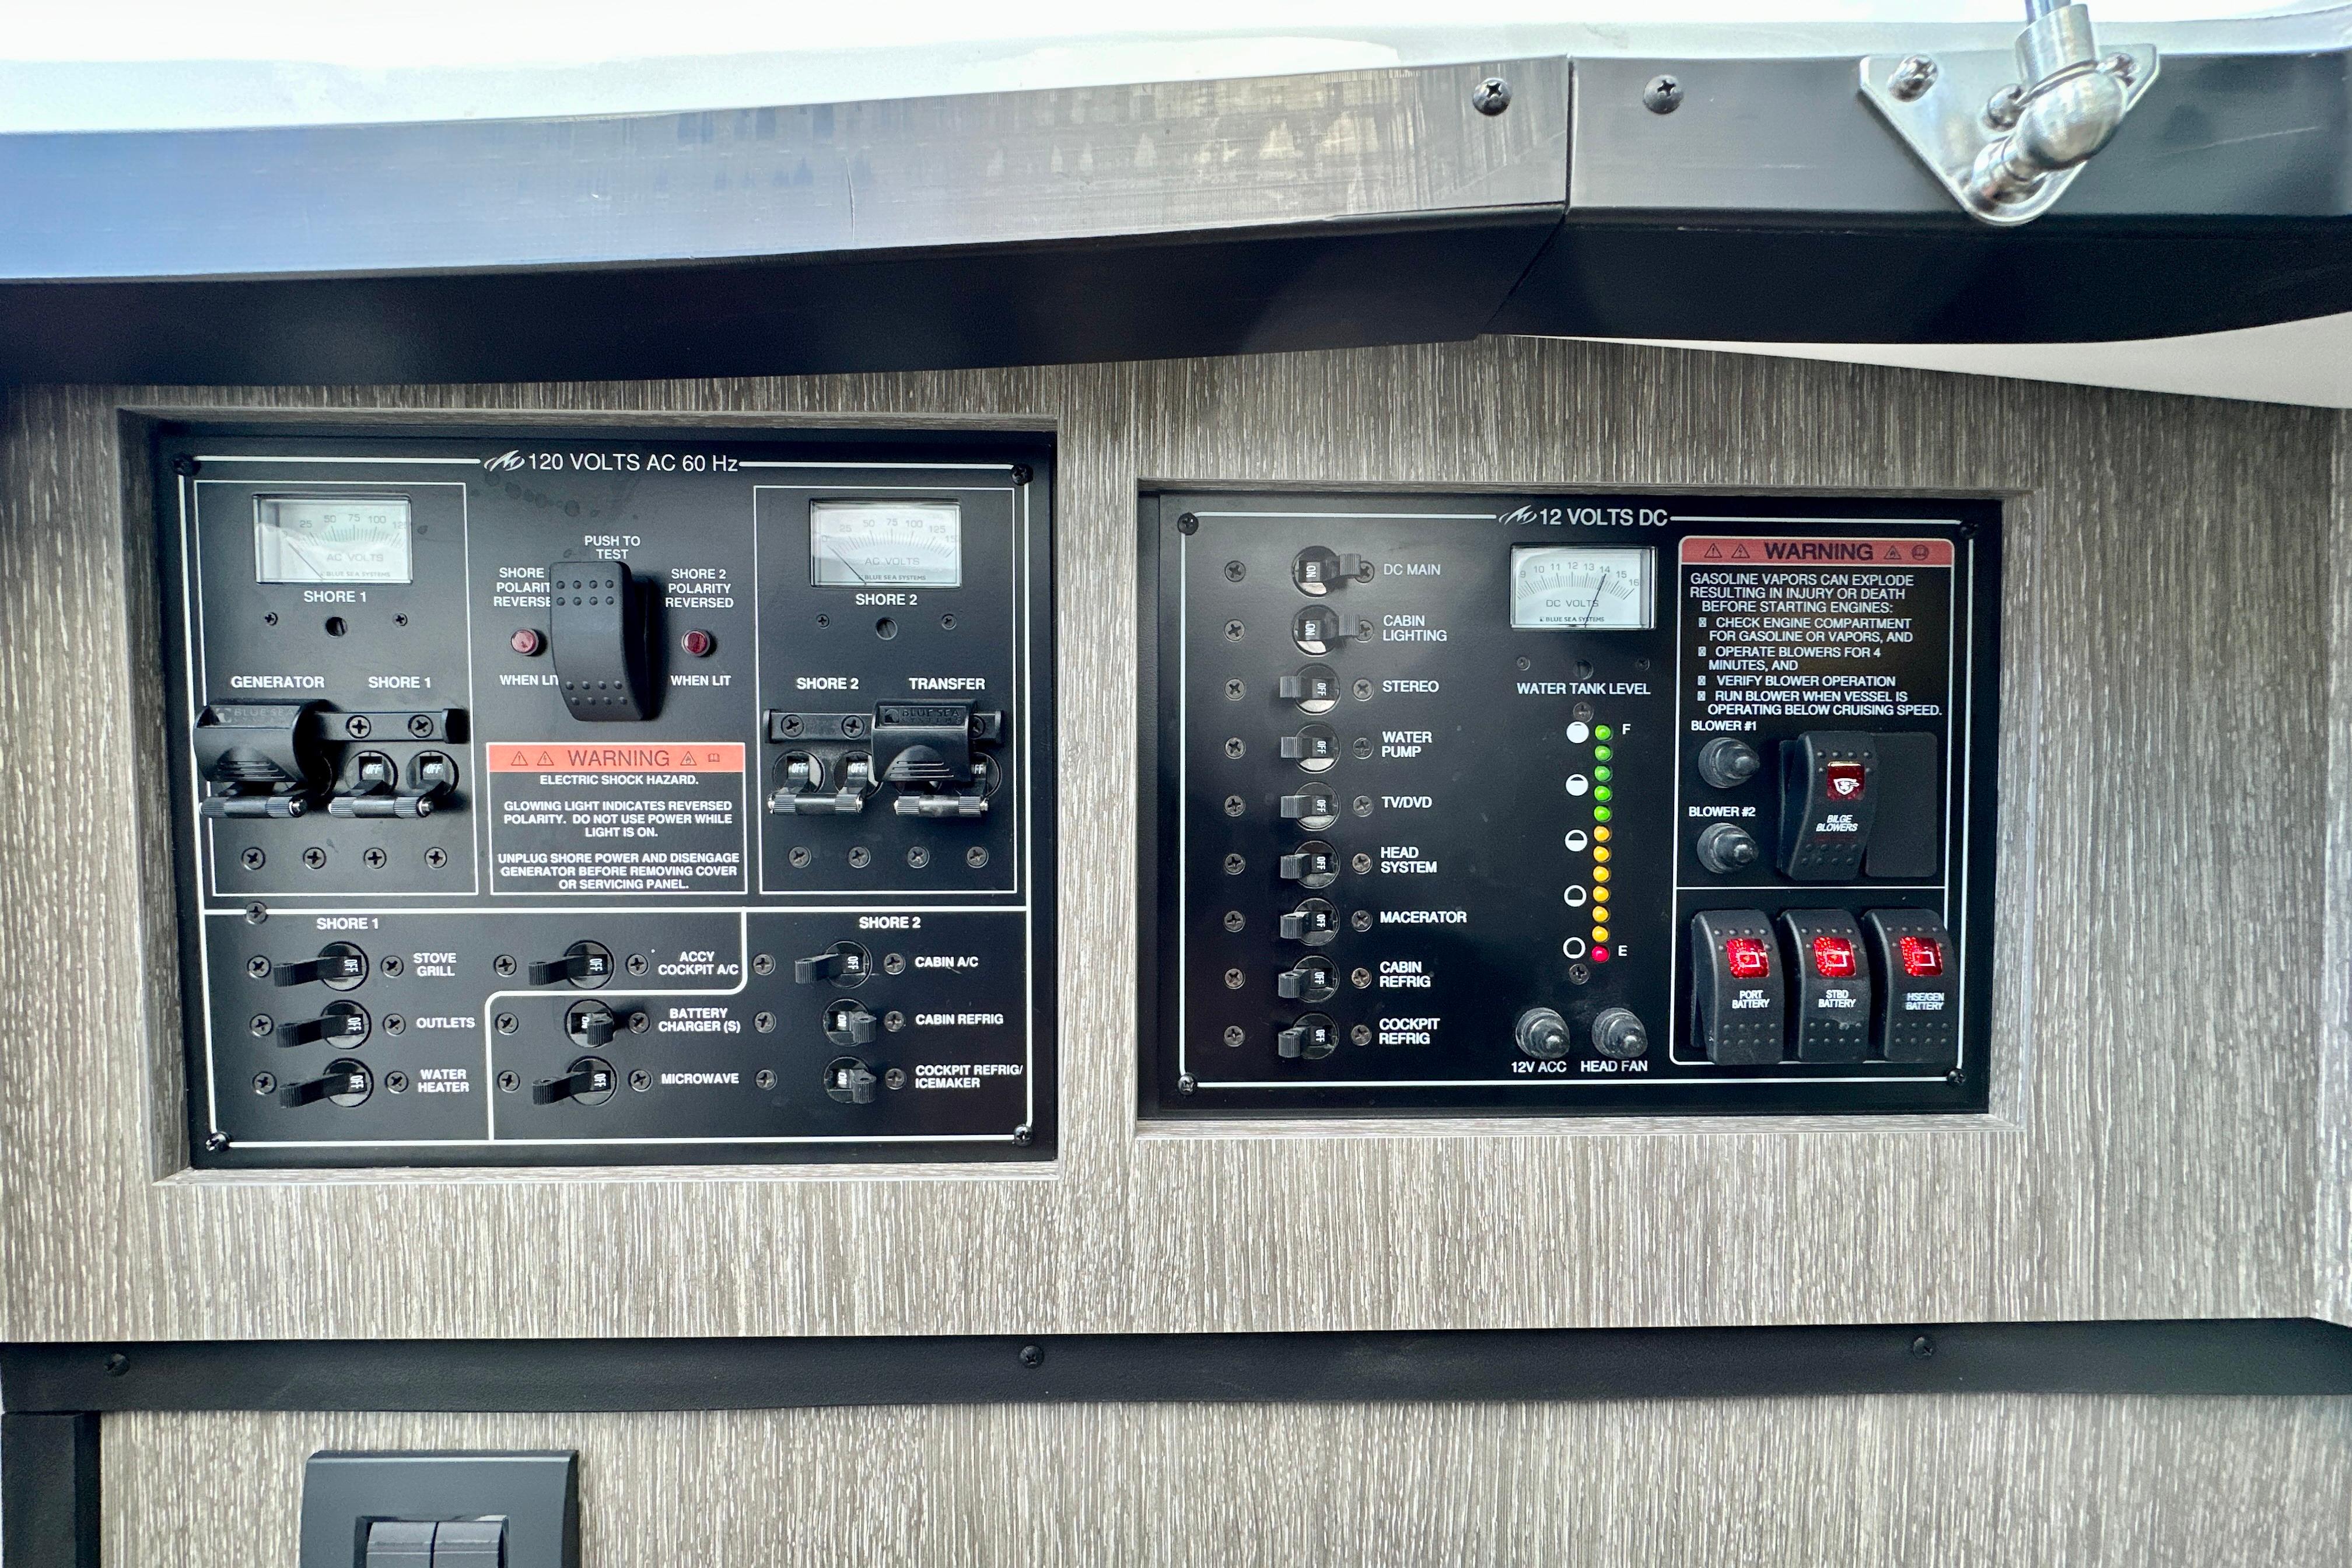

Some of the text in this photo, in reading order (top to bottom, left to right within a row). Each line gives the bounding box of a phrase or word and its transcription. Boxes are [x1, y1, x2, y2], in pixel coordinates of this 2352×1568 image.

[528, 453, 738, 472] 120 VOLTS AC 60 Hz
[1539, 508, 1668, 526] 12 VOLTS DC
[584, 535, 641, 547] PUSH TO
[596, 548, 629, 560] TEST
[1764, 542, 1874, 561] WARNING
[671, 568, 726, 579] SHORE 2
[1384, 564, 1441, 576] DC MAIN
[1534, 561, 1628, 579] 10 11 12 13 14 15
[1690, 572, 1914, 586] GASOLINE VAPORS CAN EXPLODE
[668, 583, 732, 594] POLARITY
[1690, 586, 1905, 600] RESULTING IN INJURY OR DEATH
[304, 590, 366, 603] SHORE 1
[665, 597, 734, 608] REVERSED
[855, 593, 918, 606] SHORE 2
[1546, 599, 1599, 607] DC VOLTS
[1702, 600, 1894, 614] BEFORE STARTING ENGINES:
[1383, 614, 1425, 626] CABIN
[1716, 617, 1912, 629] CHECK ENGINE COMPARTMENT
[1382, 629, 1447, 642] LIGHTING
[1715, 646, 1881, 658] OPERATE BLOWERS FOR 4
[230, 676, 325, 688] GENERATOR
[368, 676, 431, 688] SHORE 1
[670, 675, 732, 686] WHEN LIT
[796, 677, 859, 690] SHORE 2
[908, 677, 985, 690] TRANSFER
[1382, 680, 1439, 692] STEREO
[1716, 675, 1896, 687] VERIFY BLOWER OPERATION
[1516, 682, 1651, 695] WATER TANK LEVEL
[1715, 690, 1908, 702] RUN BLOWER WHEN VESSEL IS
[1707, 704, 1943, 716] OPERATING BELOW CRUISING SPEED.
[1690, 720, 1756, 732] BLOWER #1
[1382, 731, 1433, 743] WATER
[567, 750, 670, 766] WARNING
[1381, 746, 1422, 758] PUMP
[792, 762, 806, 774] OFF
[851, 762, 865, 773] OFF
[540, 774, 699, 785] ELECTRIC SHOCK HAZARD.
[503, 800, 732, 811] GLOWING LIGHT INDICATES REVERSED
[1381, 796, 1433, 808] TV/DVD
[1689, 806, 1756, 817] BLOWER #2
[503, 814, 733, 824] POLARITY. DO NOT USE POWER WHILE
[1826, 814, 1853, 824] BILGE
[1815, 822, 1859, 832] BLOWERS
[496, 852, 740, 864] UNPLUG SHORE POWER AND DISENGAGE
[1381, 846, 1419, 859] HEAD
[499, 866, 737, 877] GENERATOR BEFORE REMOVING COVER
[1380, 860, 1437, 873] SYSTEM
[859, 916, 921, 929] SHORE 2
[1380, 911, 1467, 923] MACERATOR
[316, 917, 379, 930] SHORE 1
[413, 953, 457, 964] STOVE
[679, 951, 715, 963] ACCY
[915, 956, 979, 968] CABIN A/C
[416, 965, 456, 977] GRILL
[658, 964, 739, 975] COCKPIT A/C
[1380, 961, 1422, 974] CABIN
[1379, 975, 1431, 988] REFRIG
[1738, 989, 1764, 999] PORT
[1825, 989, 1849, 998] STBD
[1731, 999, 1770, 1009] BATTERY
[1818, 998, 1857, 1008] BATTERY
[670, 1007, 728, 1019] BATTERY
[416, 1017, 475, 1028] OUTLETS
[915, 1013, 1004, 1026] CABIN REFRIG
[1379, 1018, 1441, 1031] COCKPIT
[658, 1020, 741, 1034] CHARGER (S)
[1379, 1032, 1430, 1045] REFRIG
[915, 1064, 1023, 1076] COCKPIT REFRIG/
[1511, 1060, 1567, 1073] 12V ACC
[1580, 1060, 1648, 1072] HEAD FAN
[420, 1069, 467, 1080] WATER
[661, 1073, 740, 1084] MICROWAVE
[418, 1082, 470, 1093] HEATER
[915, 1077, 981, 1089] ICEMAKER
